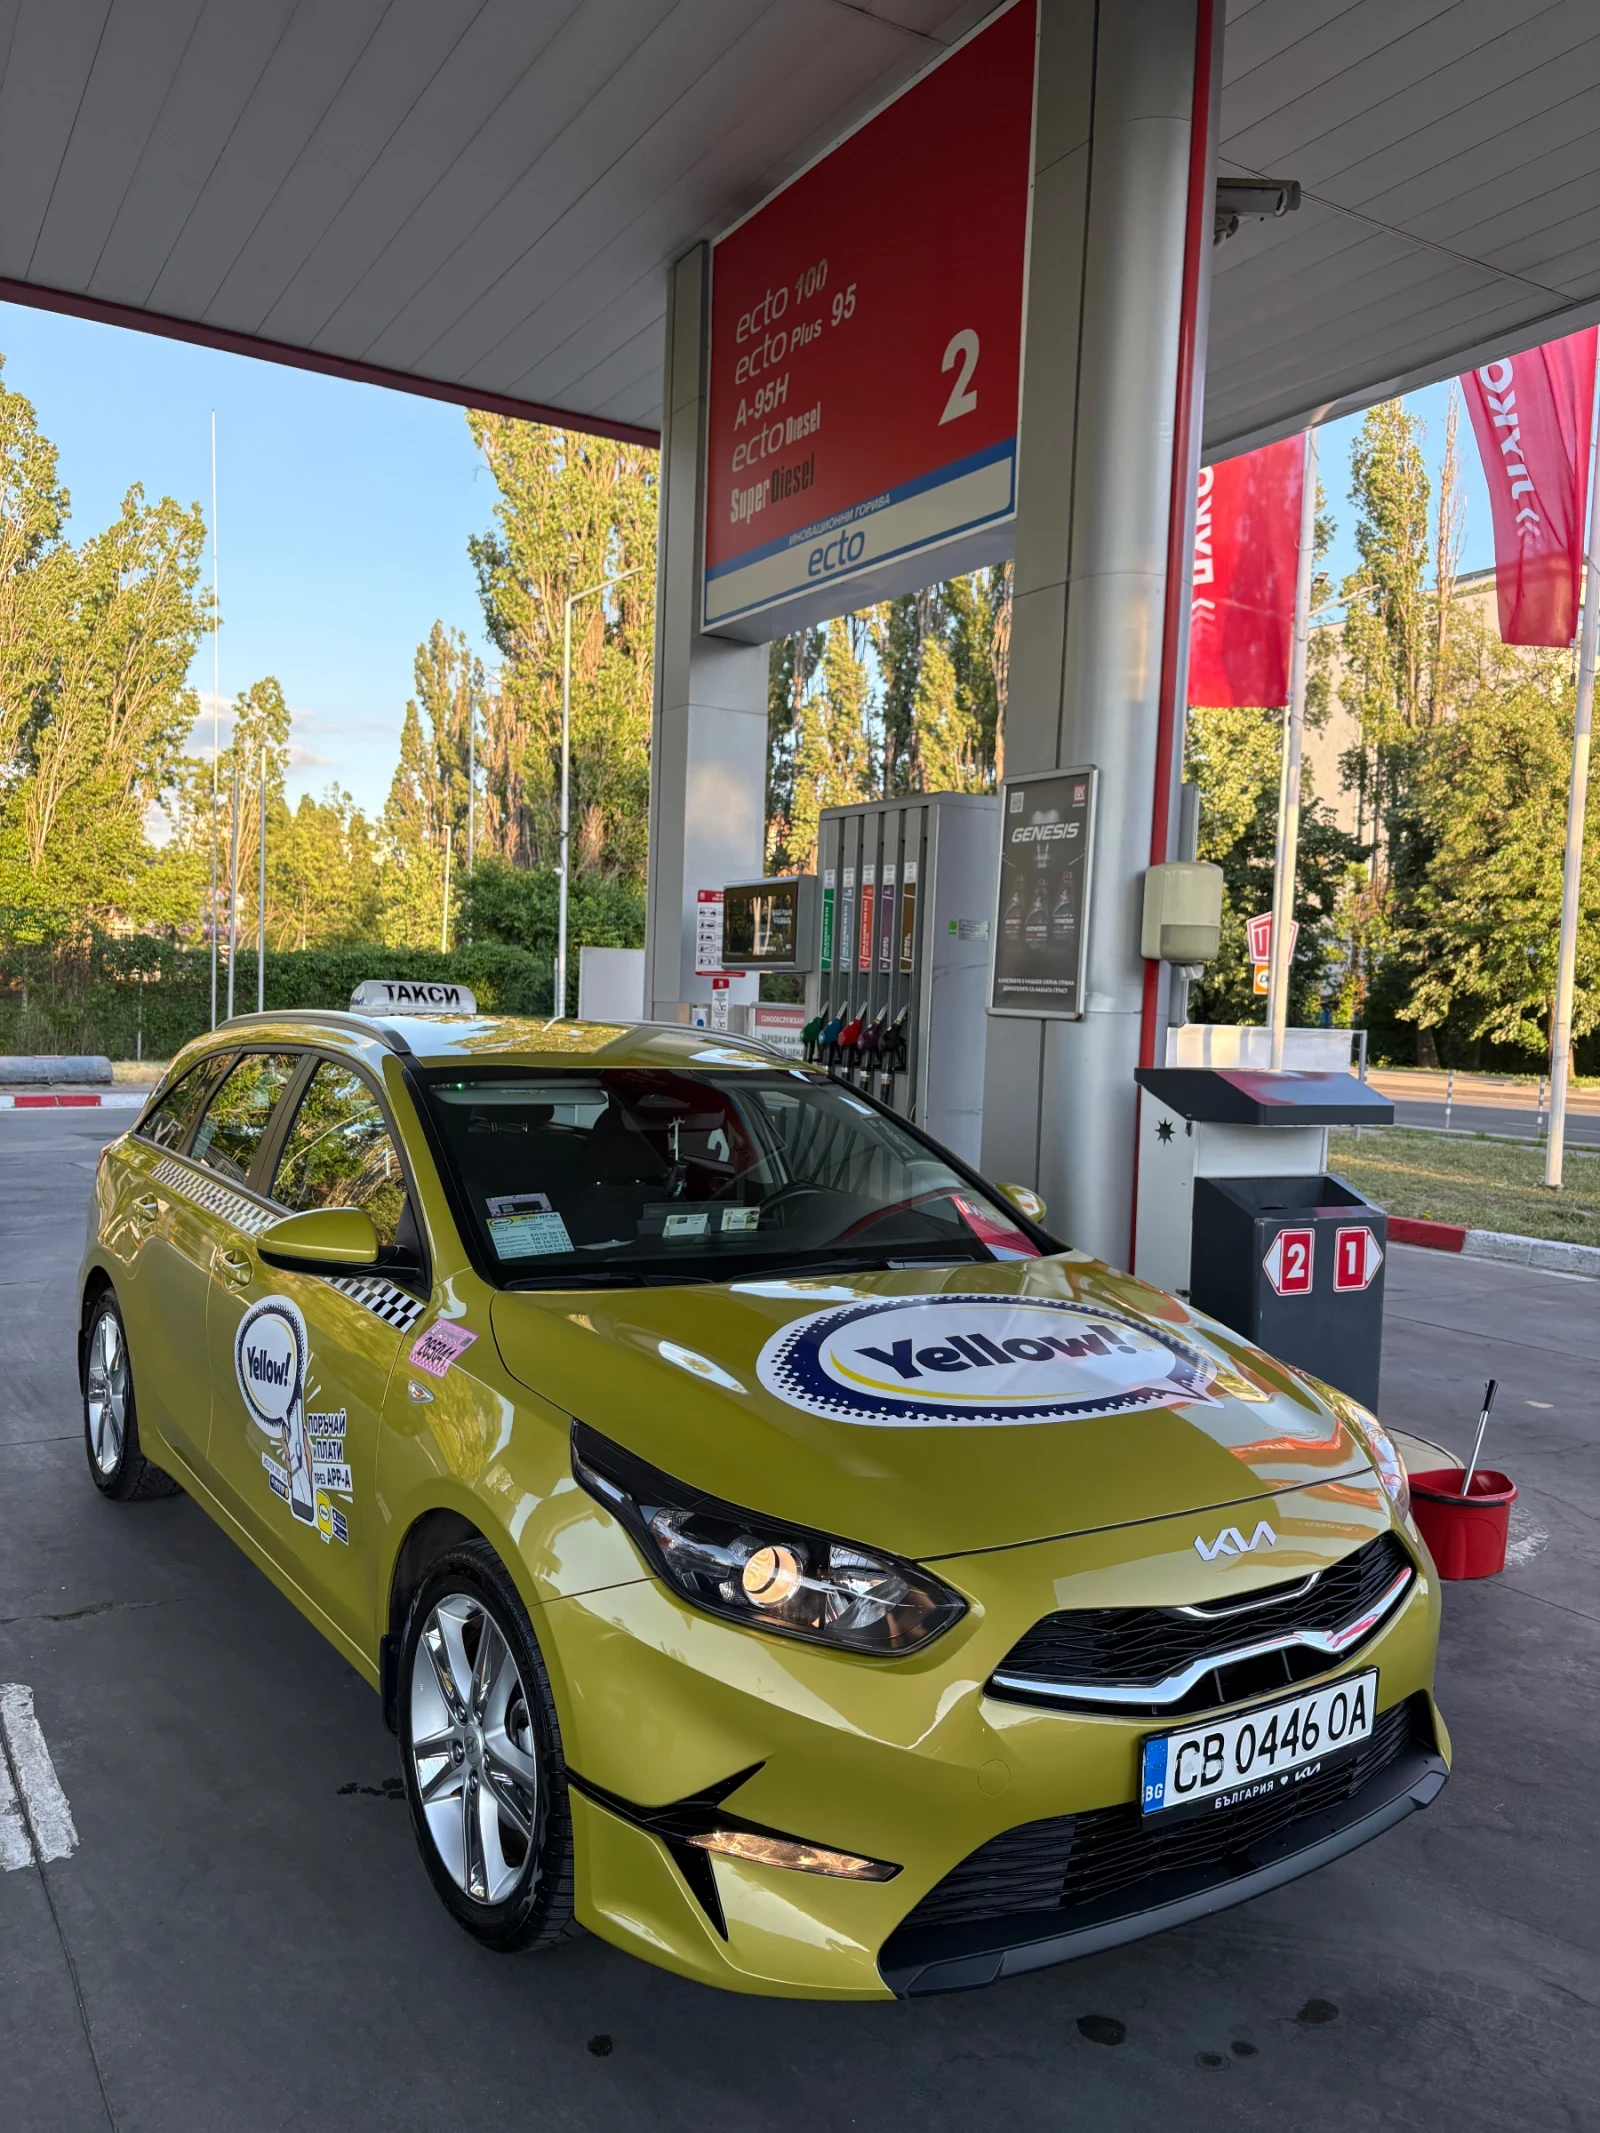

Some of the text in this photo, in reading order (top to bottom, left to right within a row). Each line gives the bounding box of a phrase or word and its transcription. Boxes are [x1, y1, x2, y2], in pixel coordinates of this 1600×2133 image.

[736, 258, 828, 344] ecto 100
[735, 282, 857, 385] ecto Plus 95
[938, 328, 980, 426] 2
[734, 372, 790, 432] A-95H
[789, 493, 890, 546] ИНОВАЦИОННИ ГОРИВА
[808, 529, 865, 577] ecto
[1011, 822, 1080, 843] GENESIS
[382, 984, 461, 1005] ТАКСИ
[761, 1014, 804, 1025] САМООБСЛУЖВАН
[783, 1035, 796, 1045] САМ
[1286, 1243, 1306, 1279] 2
[1346, 1241, 1357, 1275] 1
[246, 1346, 292, 1387] Yellow!
[417, 1336, 457, 1368] 265041
[853, 1324, 1137, 1379] Yellow!
[308, 1409, 346, 1436] ПОРЪЧАЙ
[316, 1440, 343, 1462] ПЛАТИ
[314, 1467, 351, 1489] ПРЕЗ APP-A
[1193, 1520, 1277, 1562] KIA
[1174, 1684, 1367, 1794] CB 0446 OA
[1145, 1782, 1164, 1801] BG
[1215, 1762, 1321, 1809] БЪЛГАРИЯ KIA
